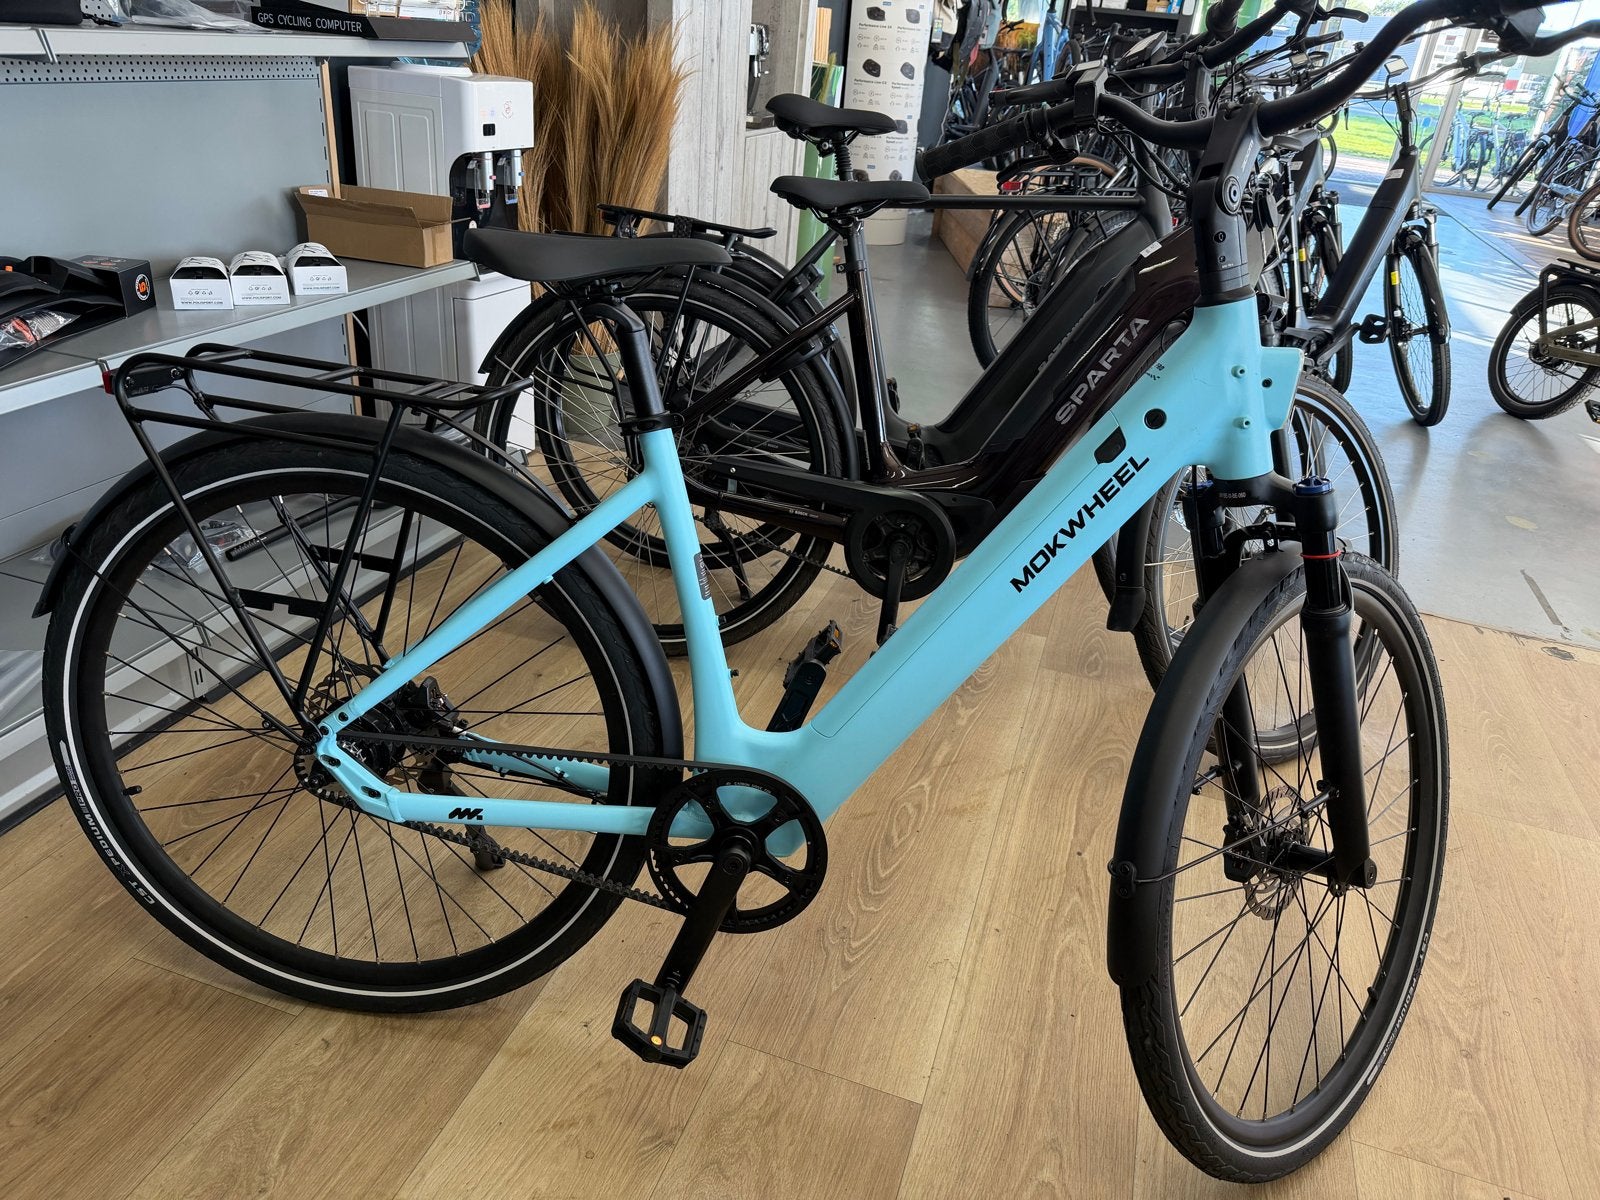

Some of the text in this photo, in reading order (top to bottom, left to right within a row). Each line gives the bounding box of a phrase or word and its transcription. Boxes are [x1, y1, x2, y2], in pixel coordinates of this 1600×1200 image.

[257, 12, 363, 33] GPS CYCLING COMPUTER
[1054, 316, 1150, 425] SPARTA
[1009, 455, 1150, 593] MOKWHEEL
[128, 880, 156, 905] CST
